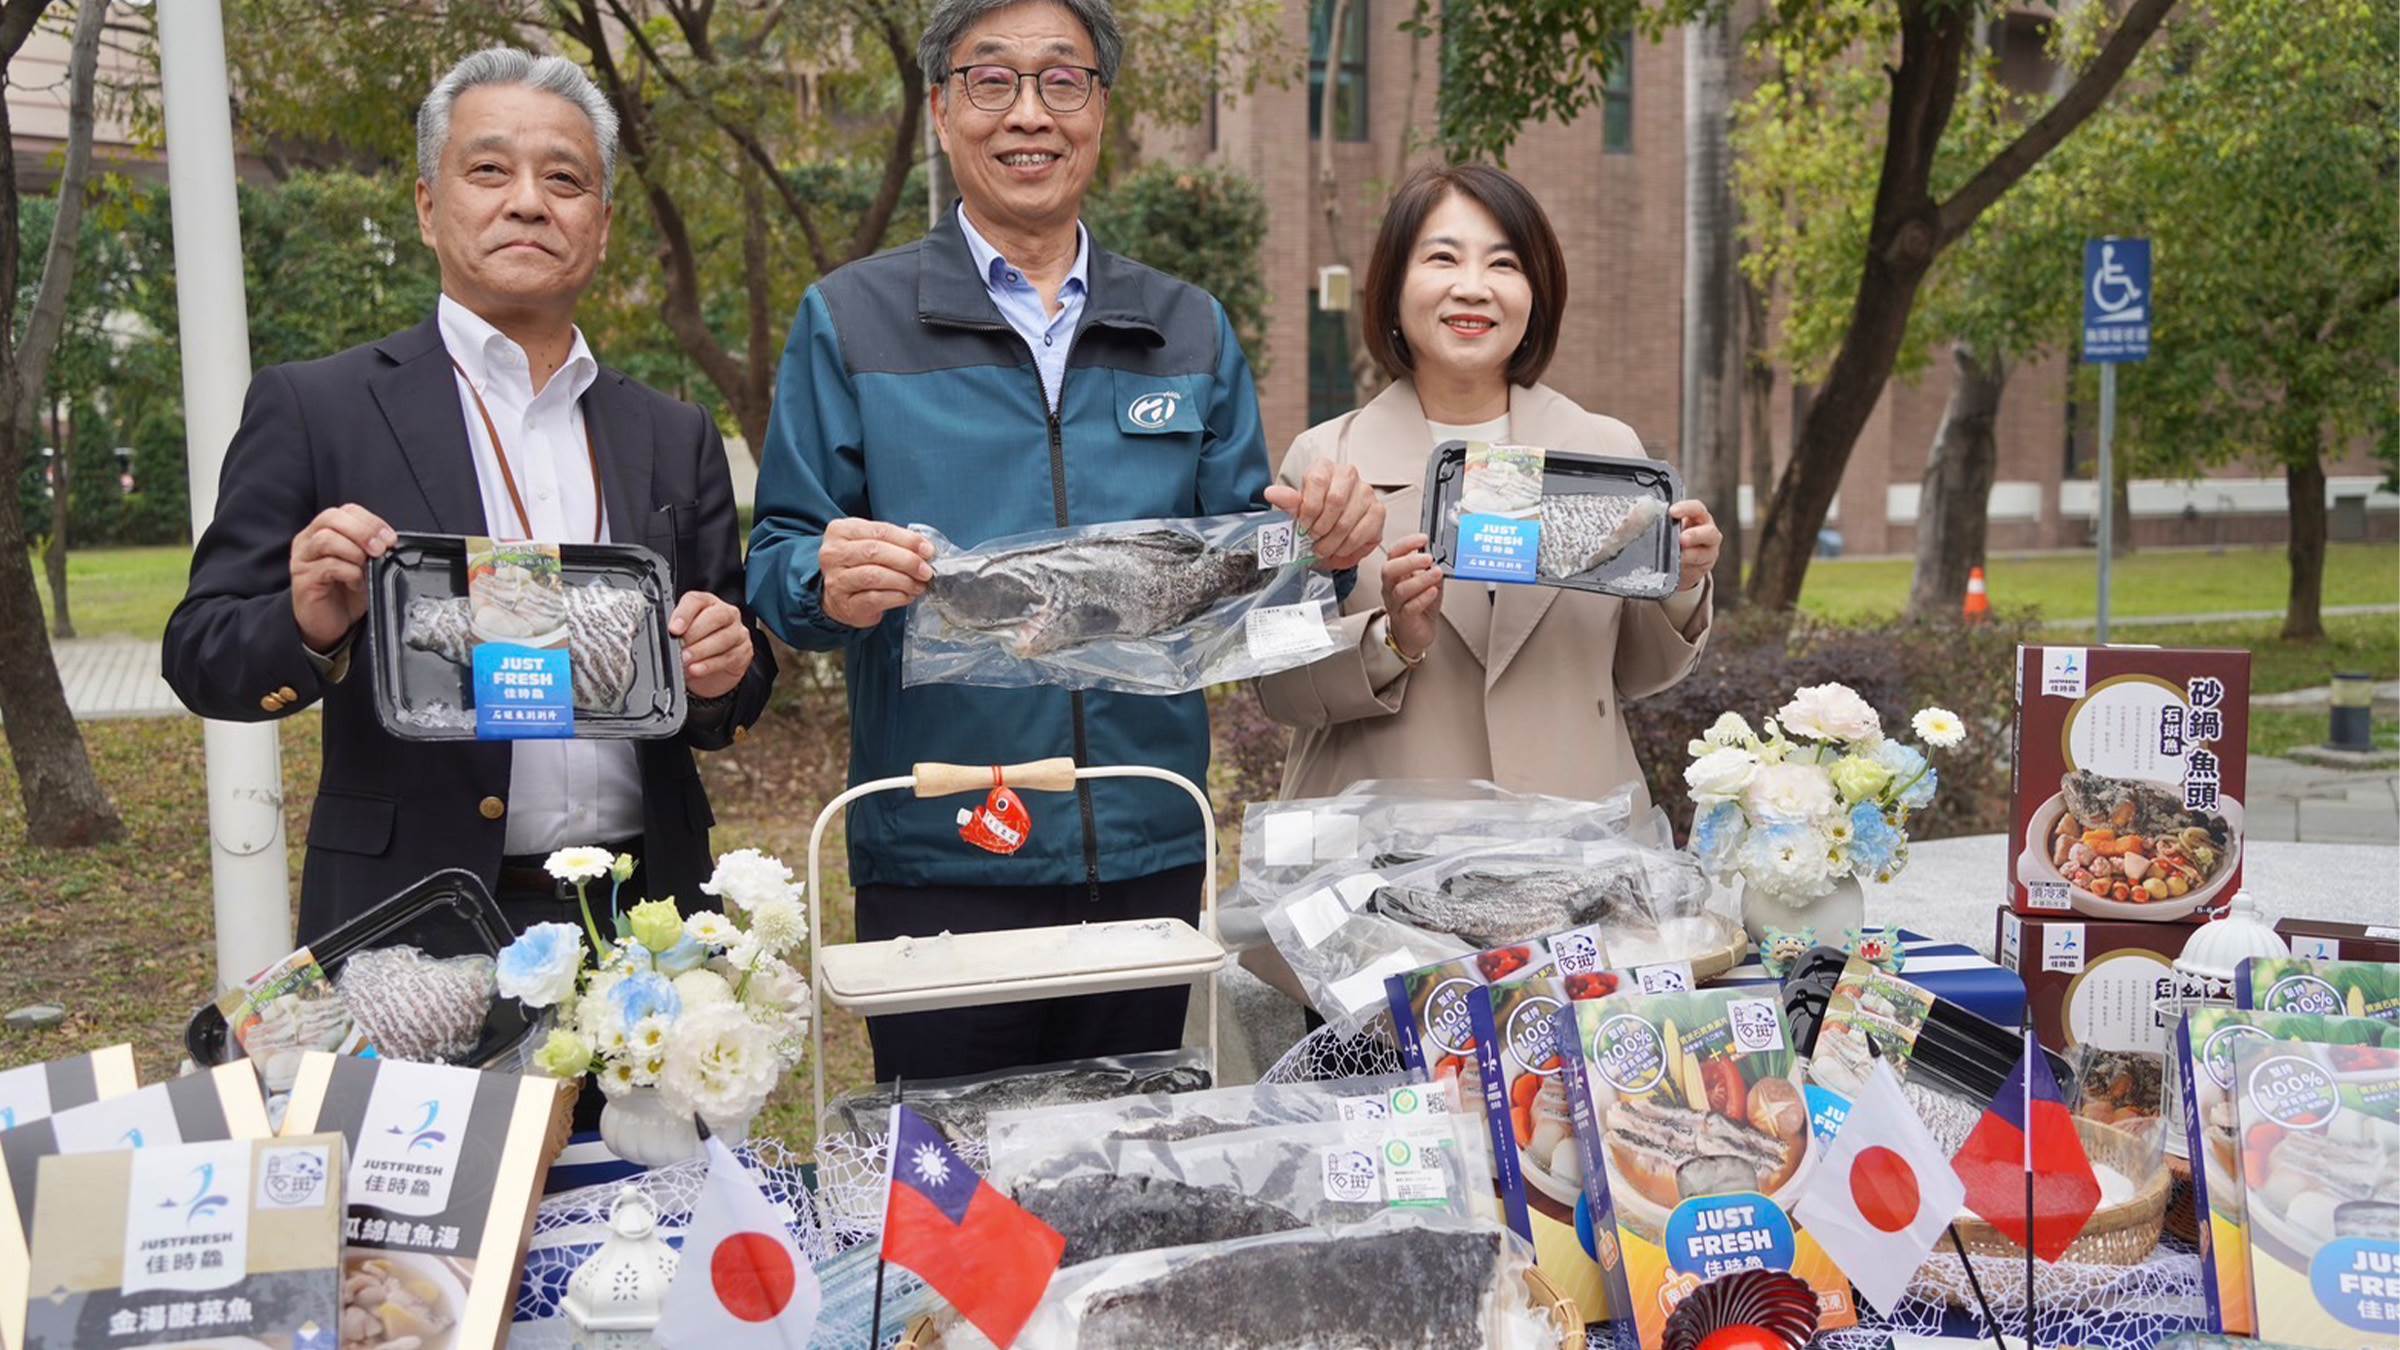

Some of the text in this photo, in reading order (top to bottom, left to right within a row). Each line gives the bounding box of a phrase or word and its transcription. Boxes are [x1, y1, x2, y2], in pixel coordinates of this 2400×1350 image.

[1474, 533, 1523, 546] FRESH
[1481, 524, 1518, 535] JUST
[500, 657, 545, 671] JUST
[493, 672, 553, 686] FRESH
[2162, 708, 2180, 754] 石斑魚
[1435, 994, 1469, 1030] 100
[1603, 1028, 1653, 1064] 100%
[2261, 1071, 2324, 1098] 100%
[1824, 1105, 1845, 1122] JU
[363, 1159, 444, 1176] JUSTFRESH
[1695, 1206, 1755, 1232] JUST
[139, 1232, 233, 1251] JUSTFRESH
[1687, 1229, 1773, 1258] FRESH
[2339, 1272, 2400, 1299] FRE
[108, 1297, 254, 1336] 金湯酸菜魚
